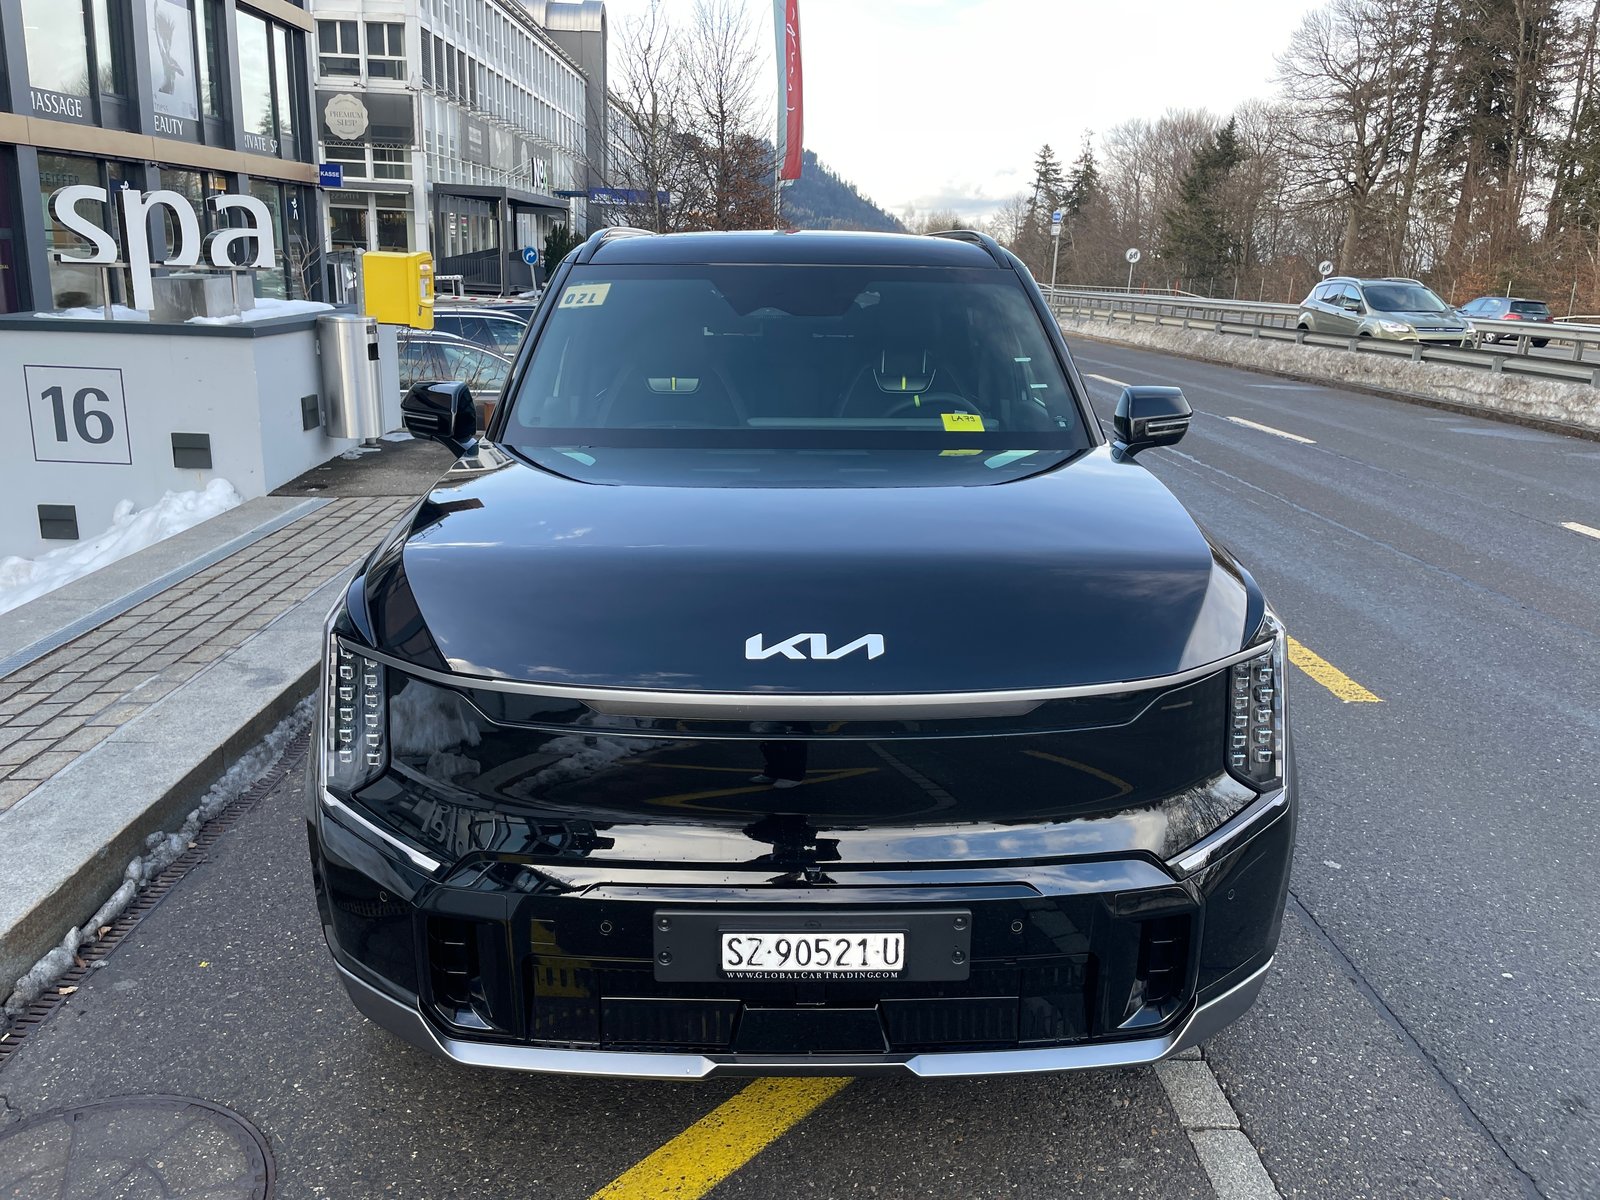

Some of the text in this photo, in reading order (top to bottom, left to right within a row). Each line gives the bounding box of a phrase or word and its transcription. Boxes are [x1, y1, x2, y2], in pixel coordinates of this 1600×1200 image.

[30, 90, 83, 118] ASSAGE
[329, 111, 364, 119] PREMIUM
[320, 170, 340, 178] KASSE
[48, 183, 276, 311] spa
[40, 385, 115, 444] 16
[745, 632, 885, 660] KIA
